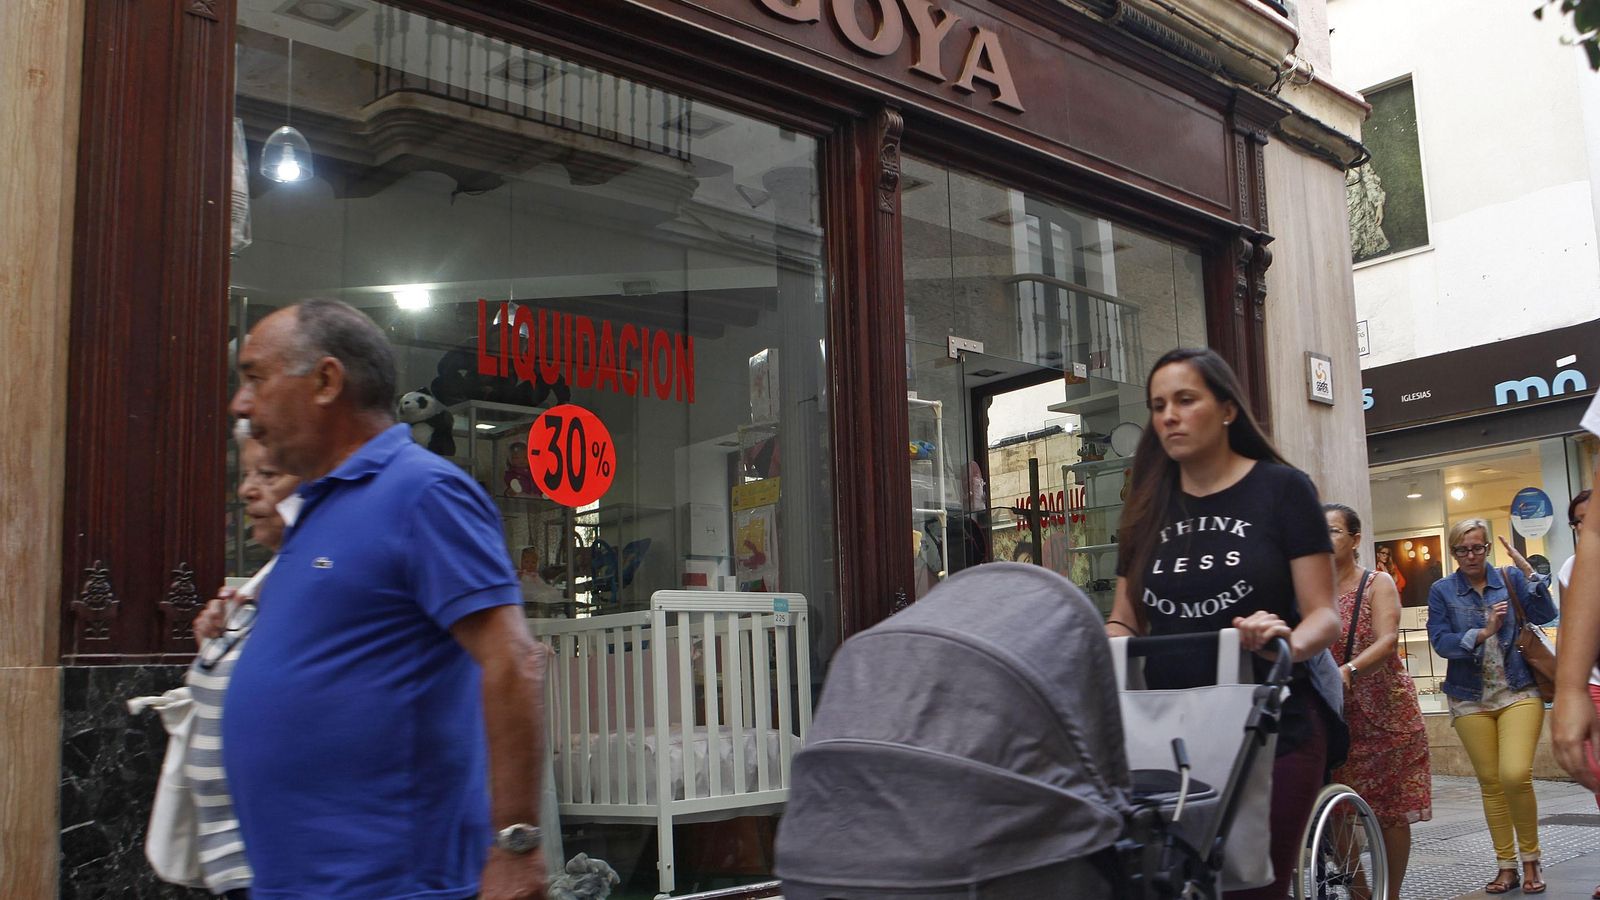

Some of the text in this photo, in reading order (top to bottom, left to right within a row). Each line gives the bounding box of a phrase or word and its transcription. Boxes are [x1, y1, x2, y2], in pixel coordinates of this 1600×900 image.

[753, 0, 1026, 113] OYA
[477, 298, 695, 404] LIQUIDACION
[1401, 390, 1432, 403] IGLESIAS
[1160, 516, 1252, 544] THINK
[1152, 551, 1241, 574] LESS
[1142, 579, 1254, 618] DO MORE
